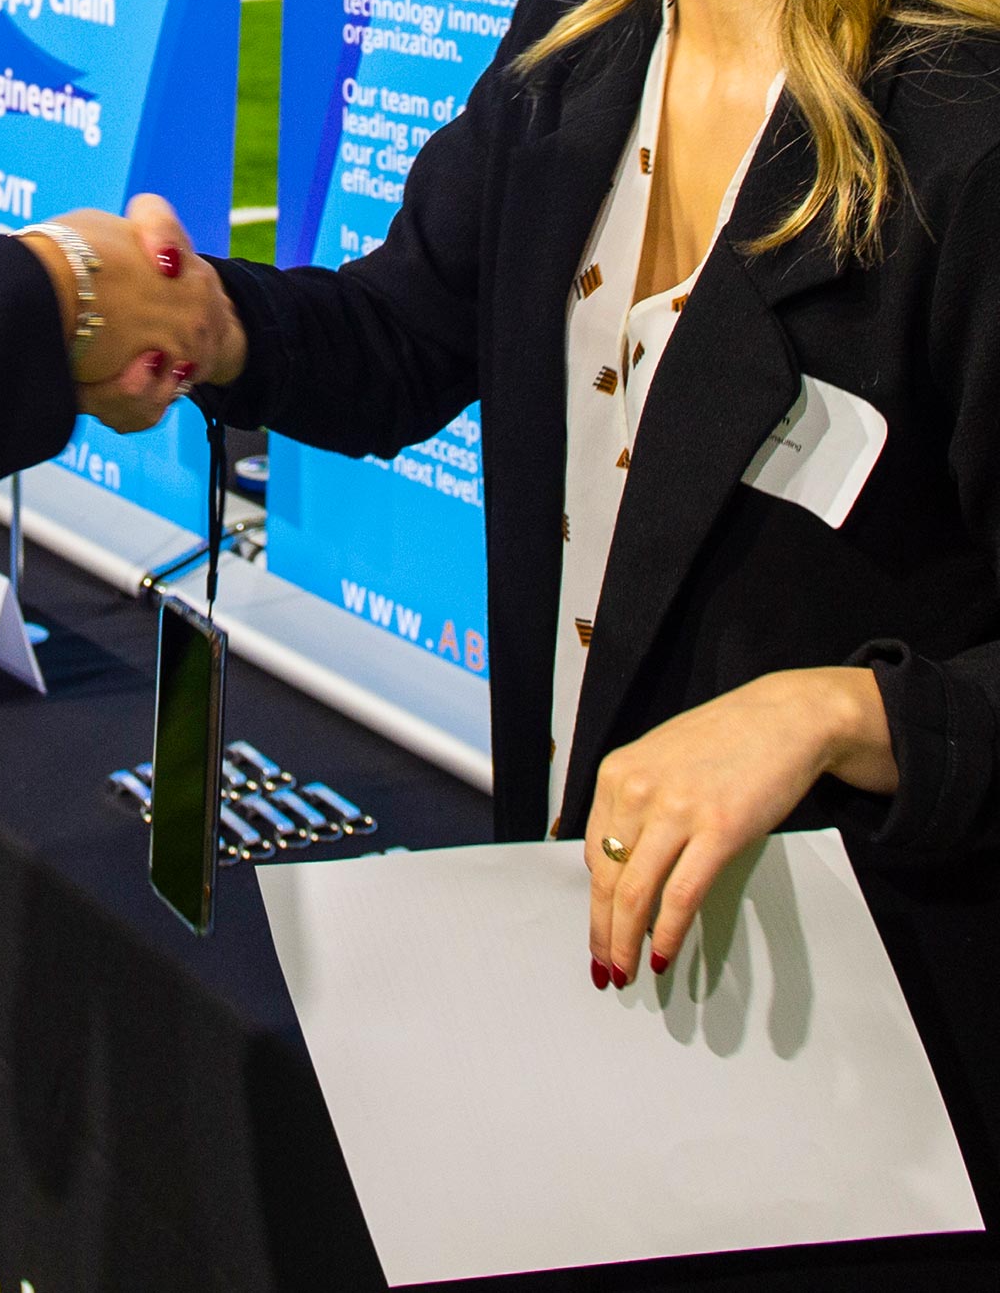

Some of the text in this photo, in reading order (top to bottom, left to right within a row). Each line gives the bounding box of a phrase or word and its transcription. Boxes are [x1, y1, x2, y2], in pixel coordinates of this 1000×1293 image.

[343, 23, 463, 64] organization.
[342, 77, 378, 106] Our
[381, 87, 430, 118] team
[432, 96, 455, 123] of
[342, 106, 409, 152] leading
[341, 141, 375, 166] our
[341, 224, 359, 252] In
[393, 454, 434, 488] next
